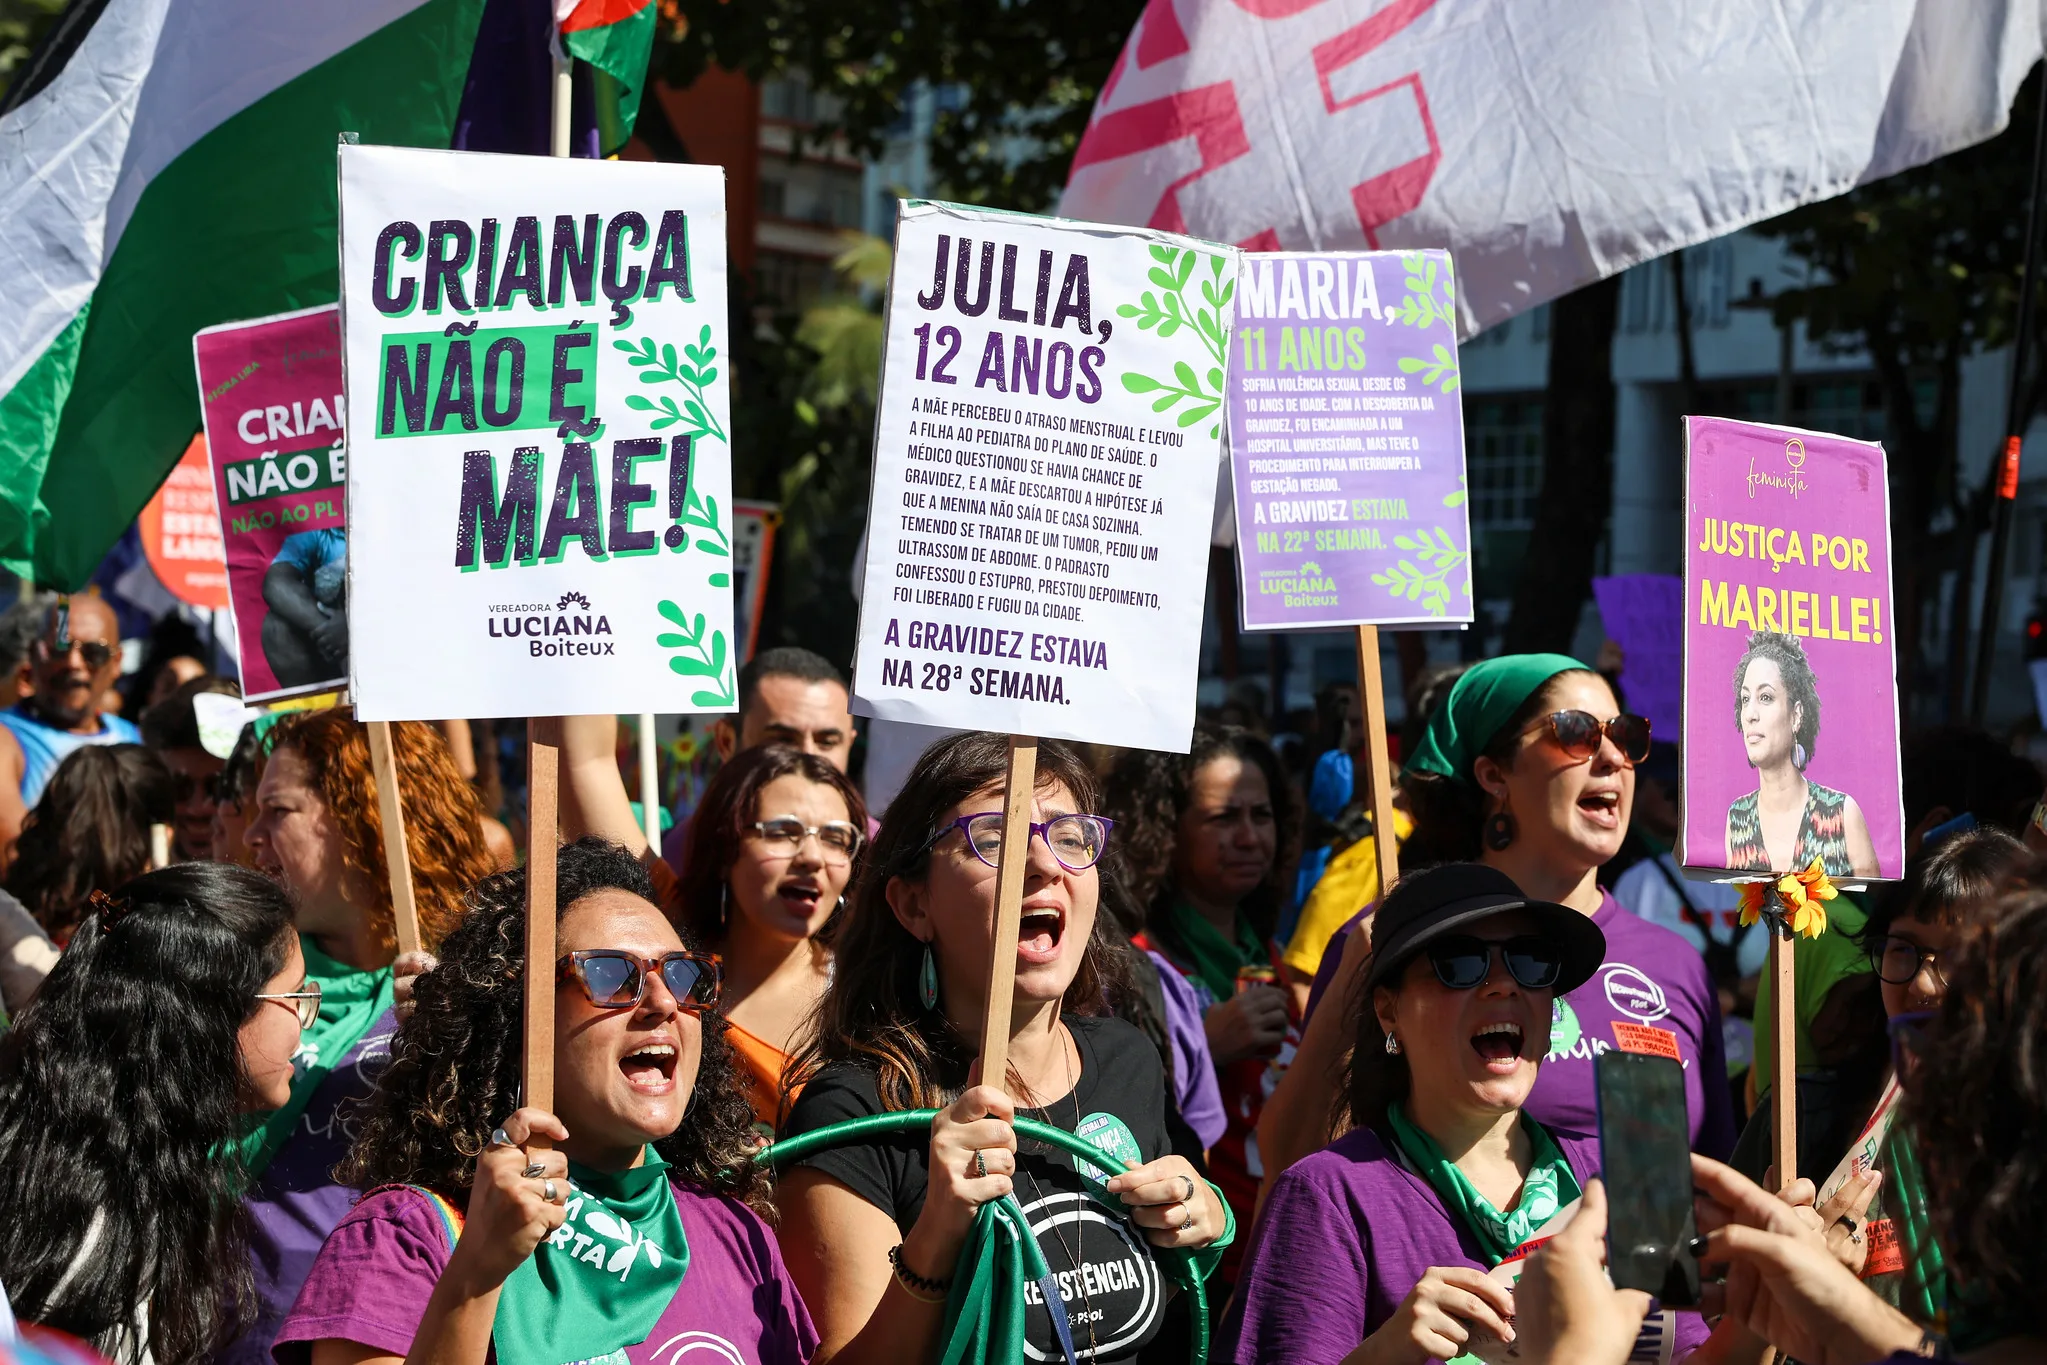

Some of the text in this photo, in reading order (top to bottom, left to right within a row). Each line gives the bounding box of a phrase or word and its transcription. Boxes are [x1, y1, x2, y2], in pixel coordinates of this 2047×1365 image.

[372, 210, 694, 326] CRIANÇA
[918, 234, 1113, 346] JULIA,
[1239, 260, 1396, 326] MARIA,
[914, 323, 1105, 404] 12 ANOS
[1239, 326, 1366, 372] 11 ANOS
[381, 320, 592, 434] NÃO É
[1242, 374, 1406, 392] SOFRIA VIOLÊNCIA SEXUAL DESDE OS
[912, 398, 1183, 447] A MÃE PERCEBEU O ATRASO MENSTRUAL E LEVOU
[1245, 397, 1434, 412] 10 ANOS DE IDADE. COM A DESCOBERTA DA
[1246, 417, 1403, 434] GRAVIDEZ, FOI ENCAMINHADA A UM
[910, 421, 1157, 467] A FILHA AO PEDIATRA DO PLANO DE SAÚDE. O
[1247, 435, 1419, 454] HOSPITAL UNIVERSITÁRIO, MAS TEVE O
[1249, 456, 1421, 474] PROCEDIMENTO PARA INTERROMPER A
[227, 450, 318, 501] NÃO
[908, 445, 1142, 488] MÉDICO QUESTIONOU SE HAVIA CHANCE DE
[1250, 476, 1341, 495] GESTAÇÃO NEGADO.
[1746, 456, 1808, 500] feminista
[455, 417, 692, 567] MÃE!
[906, 468, 1162, 515] GRAVIDEZ, E A MÃE DESCARTOU A HIPÓTESE JÁ
[1254, 498, 1409, 524] A GRAVIDEZ ESTAVA
[232, 510, 276, 534] NÃO
[281, 504, 310, 525] AO
[314, 500, 338, 519] PL
[903, 492, 1142, 536] QUE A MENINA NÃO SAÍA DE CASA SOZINHA.
[899, 540, 1109, 578] ULTRASSOM DE ABDOME. O PADRASTO
[902, 516, 1158, 561] TEMENDO SE TRATAR DE UM TUMOR, PEDIU UM
[1257, 528, 1387, 553] NA 22ª SEMANA.
[1700, 518, 1871, 573] JUSTIÇA POR
[488, 603, 552, 612] VEREADORA
[894, 587, 1084, 622] FOI LIBERADO E FUGIU DA CIDADE.
[896, 563, 1160, 610] CONFESSOU O ESTUPRO, PRESTOU DEPOIMENTO,
[1260, 577, 1336, 594] LUCIANA
[1284, 594, 1338, 607] Boiteux
[488, 616, 612, 638] LUCIANA
[1700, 580, 1883, 644] MARIELLE!
[530, 638, 614, 657] Boiteux
[884, 618, 1107, 670] A GRAVIDEZ ESTAVA
[882, 658, 1070, 705] NA 28ª SEMANA.
[548, 1222, 606, 1270] RTA
[1024, 1259, 1140, 1305] RESTÊNCIA
[1078, 1309, 1103, 1324] PSOL
